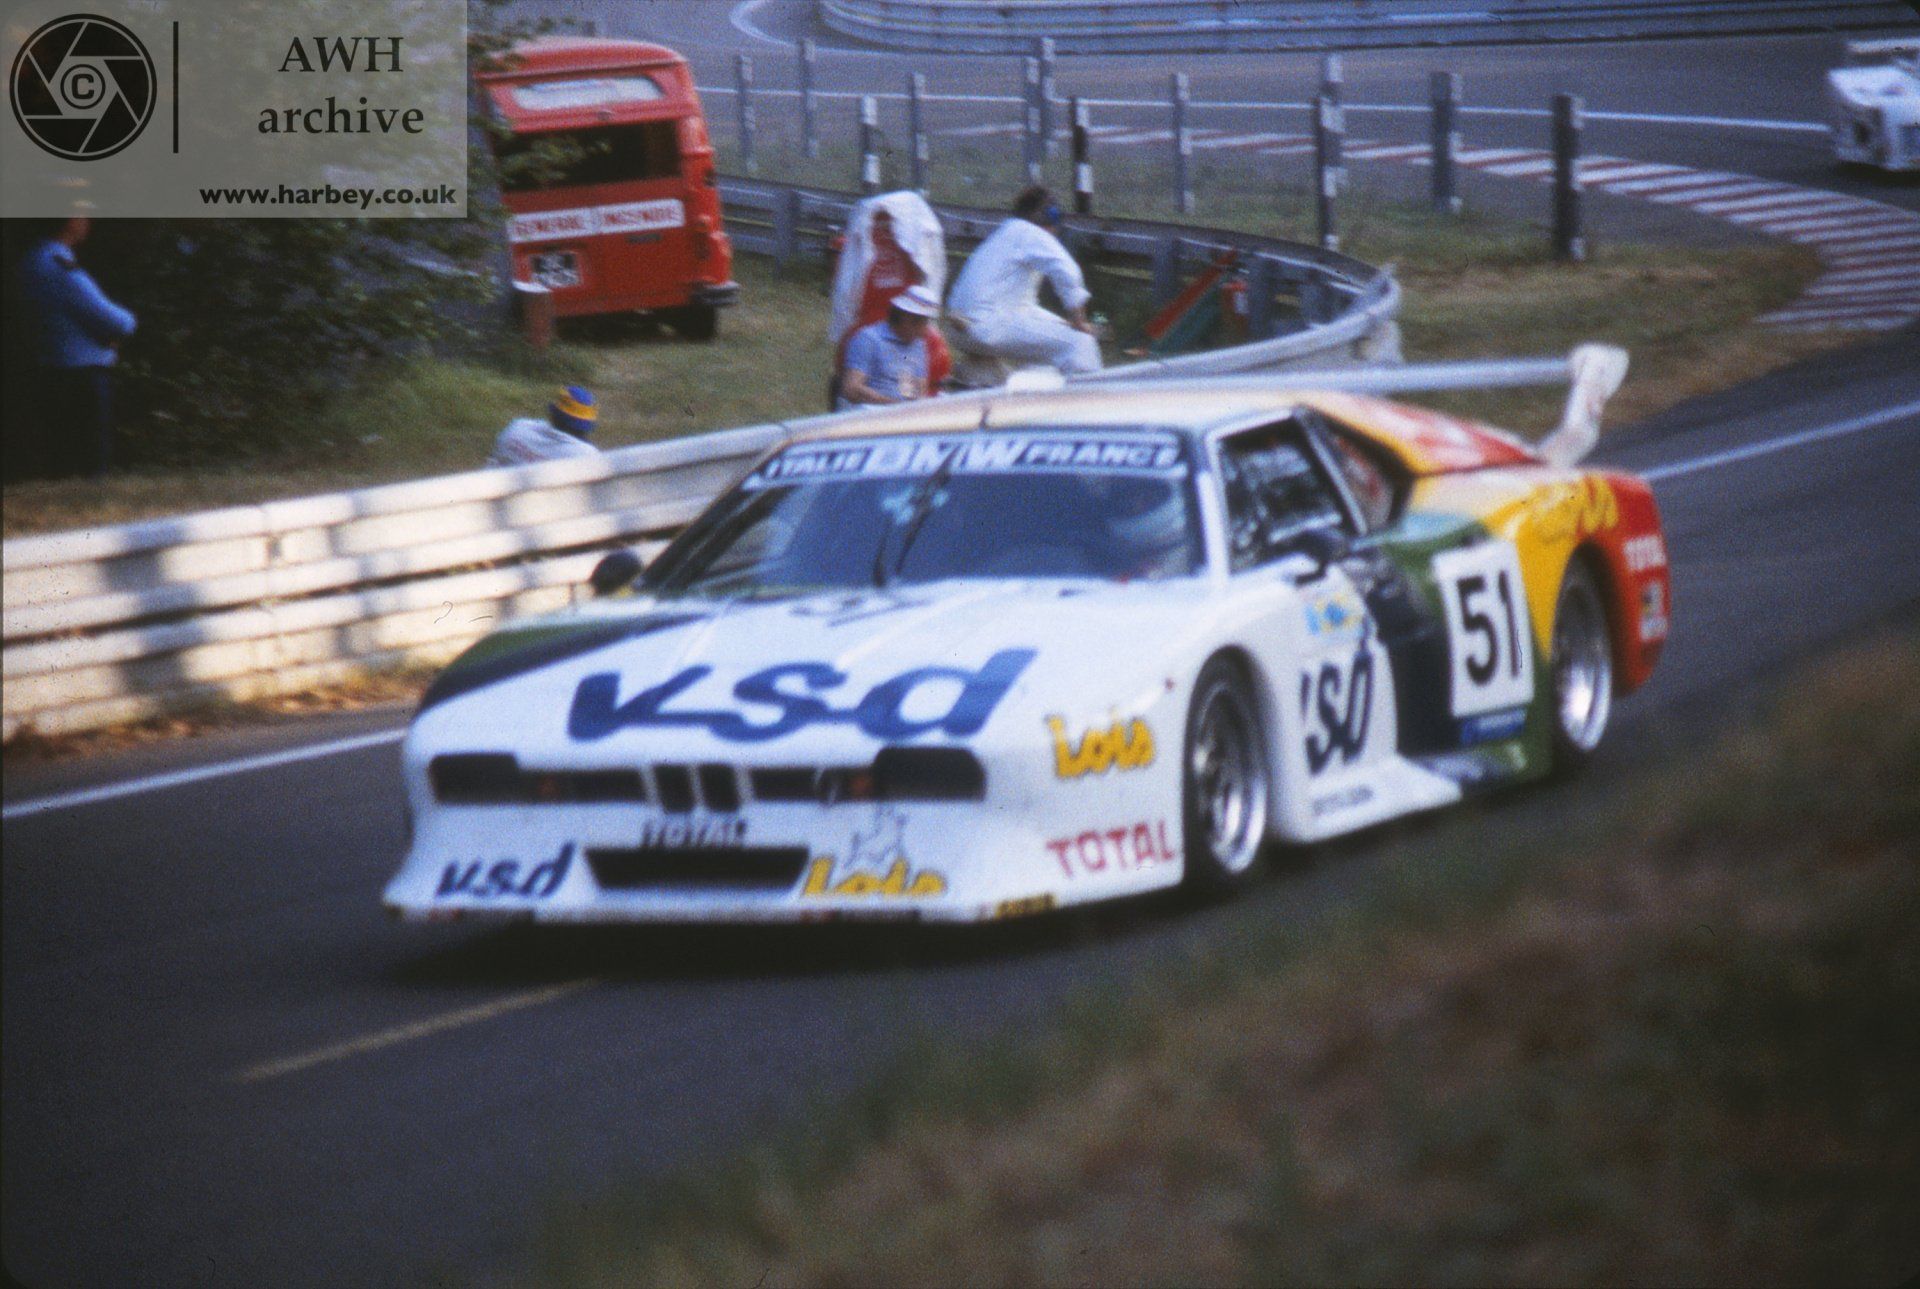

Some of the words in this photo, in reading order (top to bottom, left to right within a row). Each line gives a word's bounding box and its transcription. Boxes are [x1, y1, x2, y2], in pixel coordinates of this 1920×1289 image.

[864, 436, 1030, 475] BMW
[1025, 442, 1179, 469] FRANCE
[1456, 569, 1521, 687] 51
[1046, 712, 1156, 779] Lois
[640, 817, 747, 850] TOTAL
[1046, 820, 1175, 881] TOTAL
